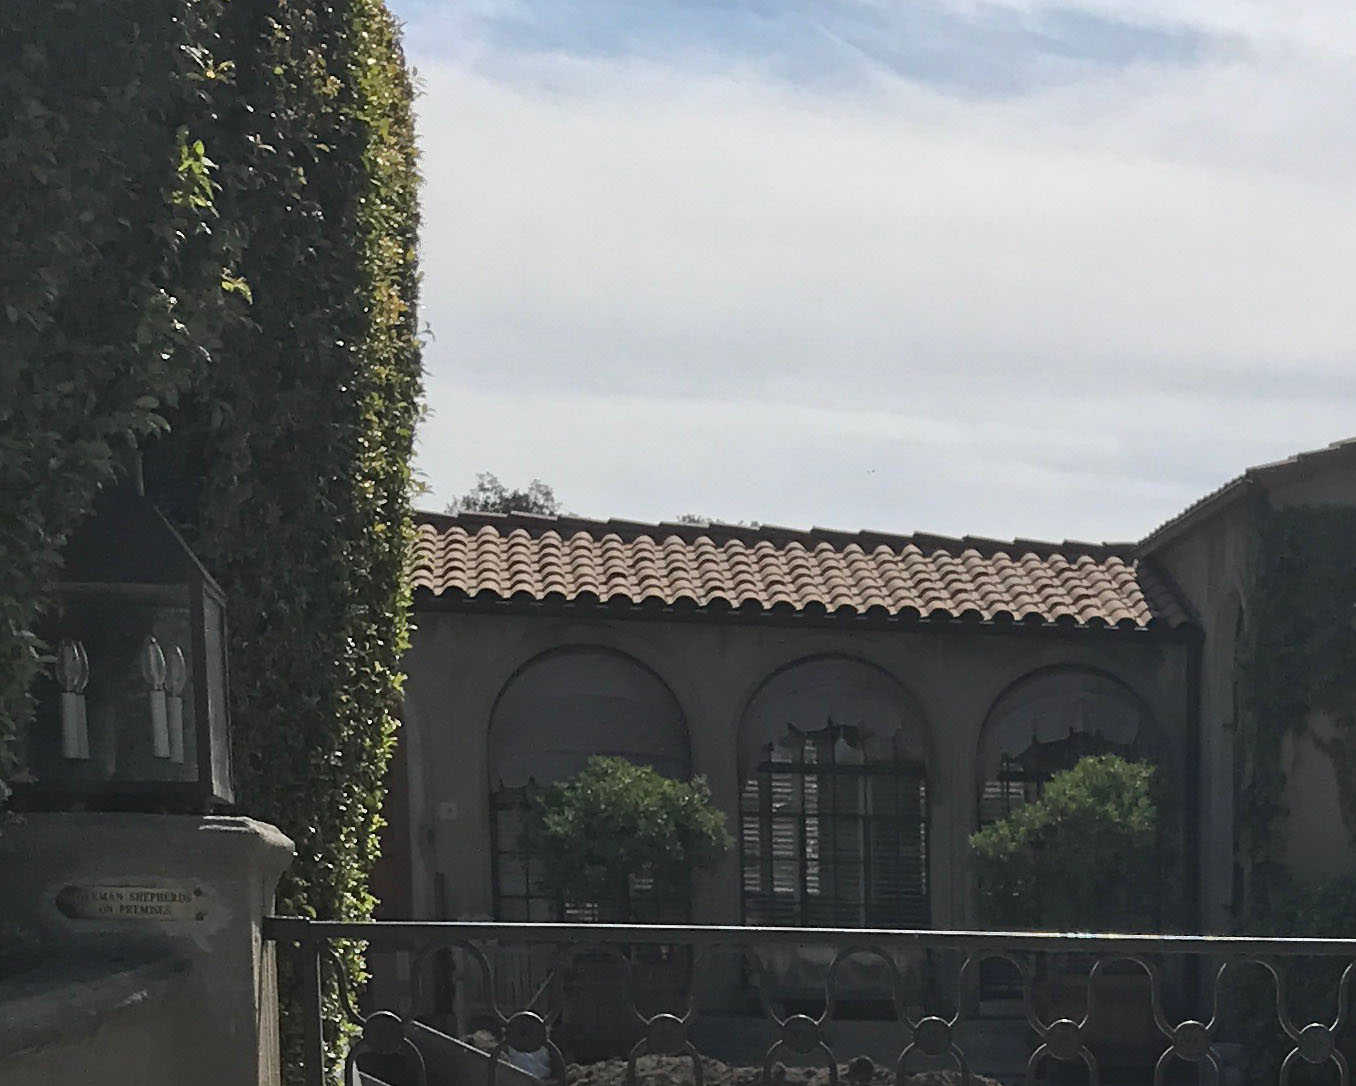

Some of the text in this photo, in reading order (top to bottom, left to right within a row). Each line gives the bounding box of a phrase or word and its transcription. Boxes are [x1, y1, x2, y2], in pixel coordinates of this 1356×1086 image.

[77, 891, 192, 903] RMAN SHEPHERDS
[98, 904, 172, 915] ON PREMISES
